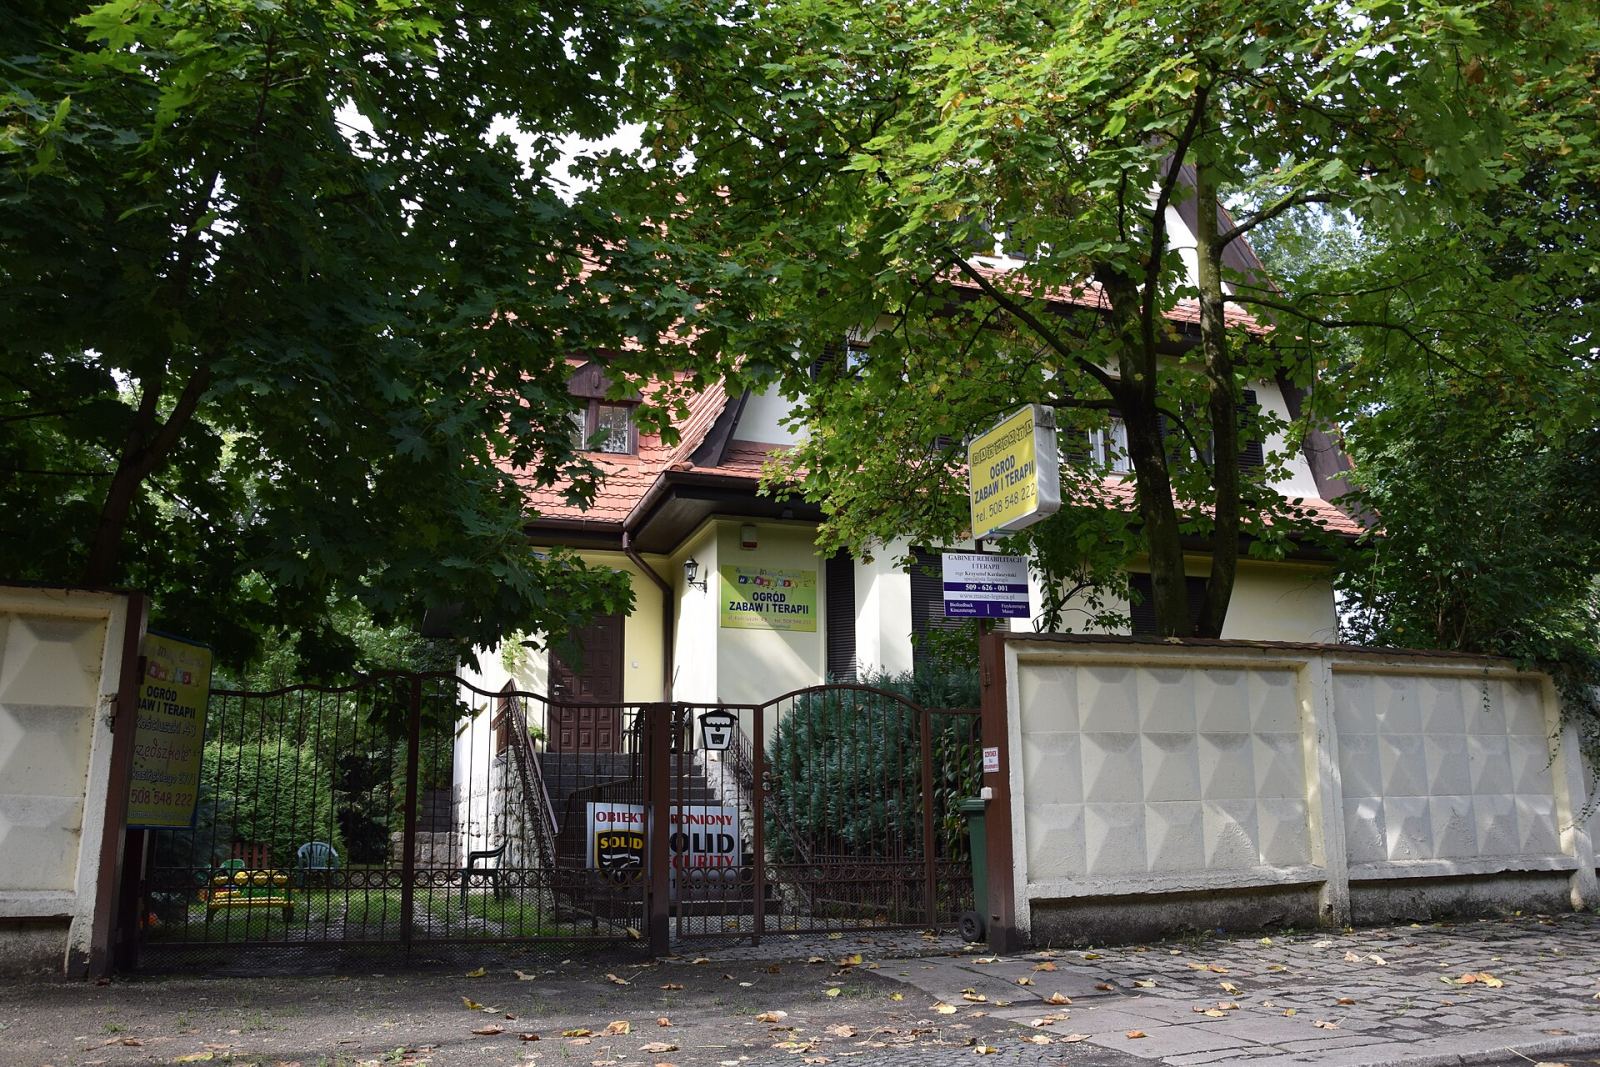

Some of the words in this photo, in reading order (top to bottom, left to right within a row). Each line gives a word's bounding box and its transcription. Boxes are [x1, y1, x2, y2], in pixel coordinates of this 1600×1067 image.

[989, 454, 1015, 480] OGRÓD
[974, 480, 999, 504] ZABAW
[1005, 460, 1034, 487] TERAPII
[976, 508, 987, 523] tel.
[989, 500, 1002, 517] 508
[1005, 492, 1018, 509] 548
[1021, 483, 1035, 500] 222
[752, 591, 786, 602] OGRÓD
[729, 601, 763, 612] ZABAW
[772, 603, 809, 614] TERAPII
[146, 685, 177, 702] OGRÓD
[163, 702, 196, 719] TERAPII
[130, 789, 151, 804] 508
[153, 790, 172, 806] 548
[175, 792, 193, 806] 222
[595, 811, 644, 823] OBIEKT
[600, 837, 643, 849] SOLID
[670, 832, 735, 854] OLID
